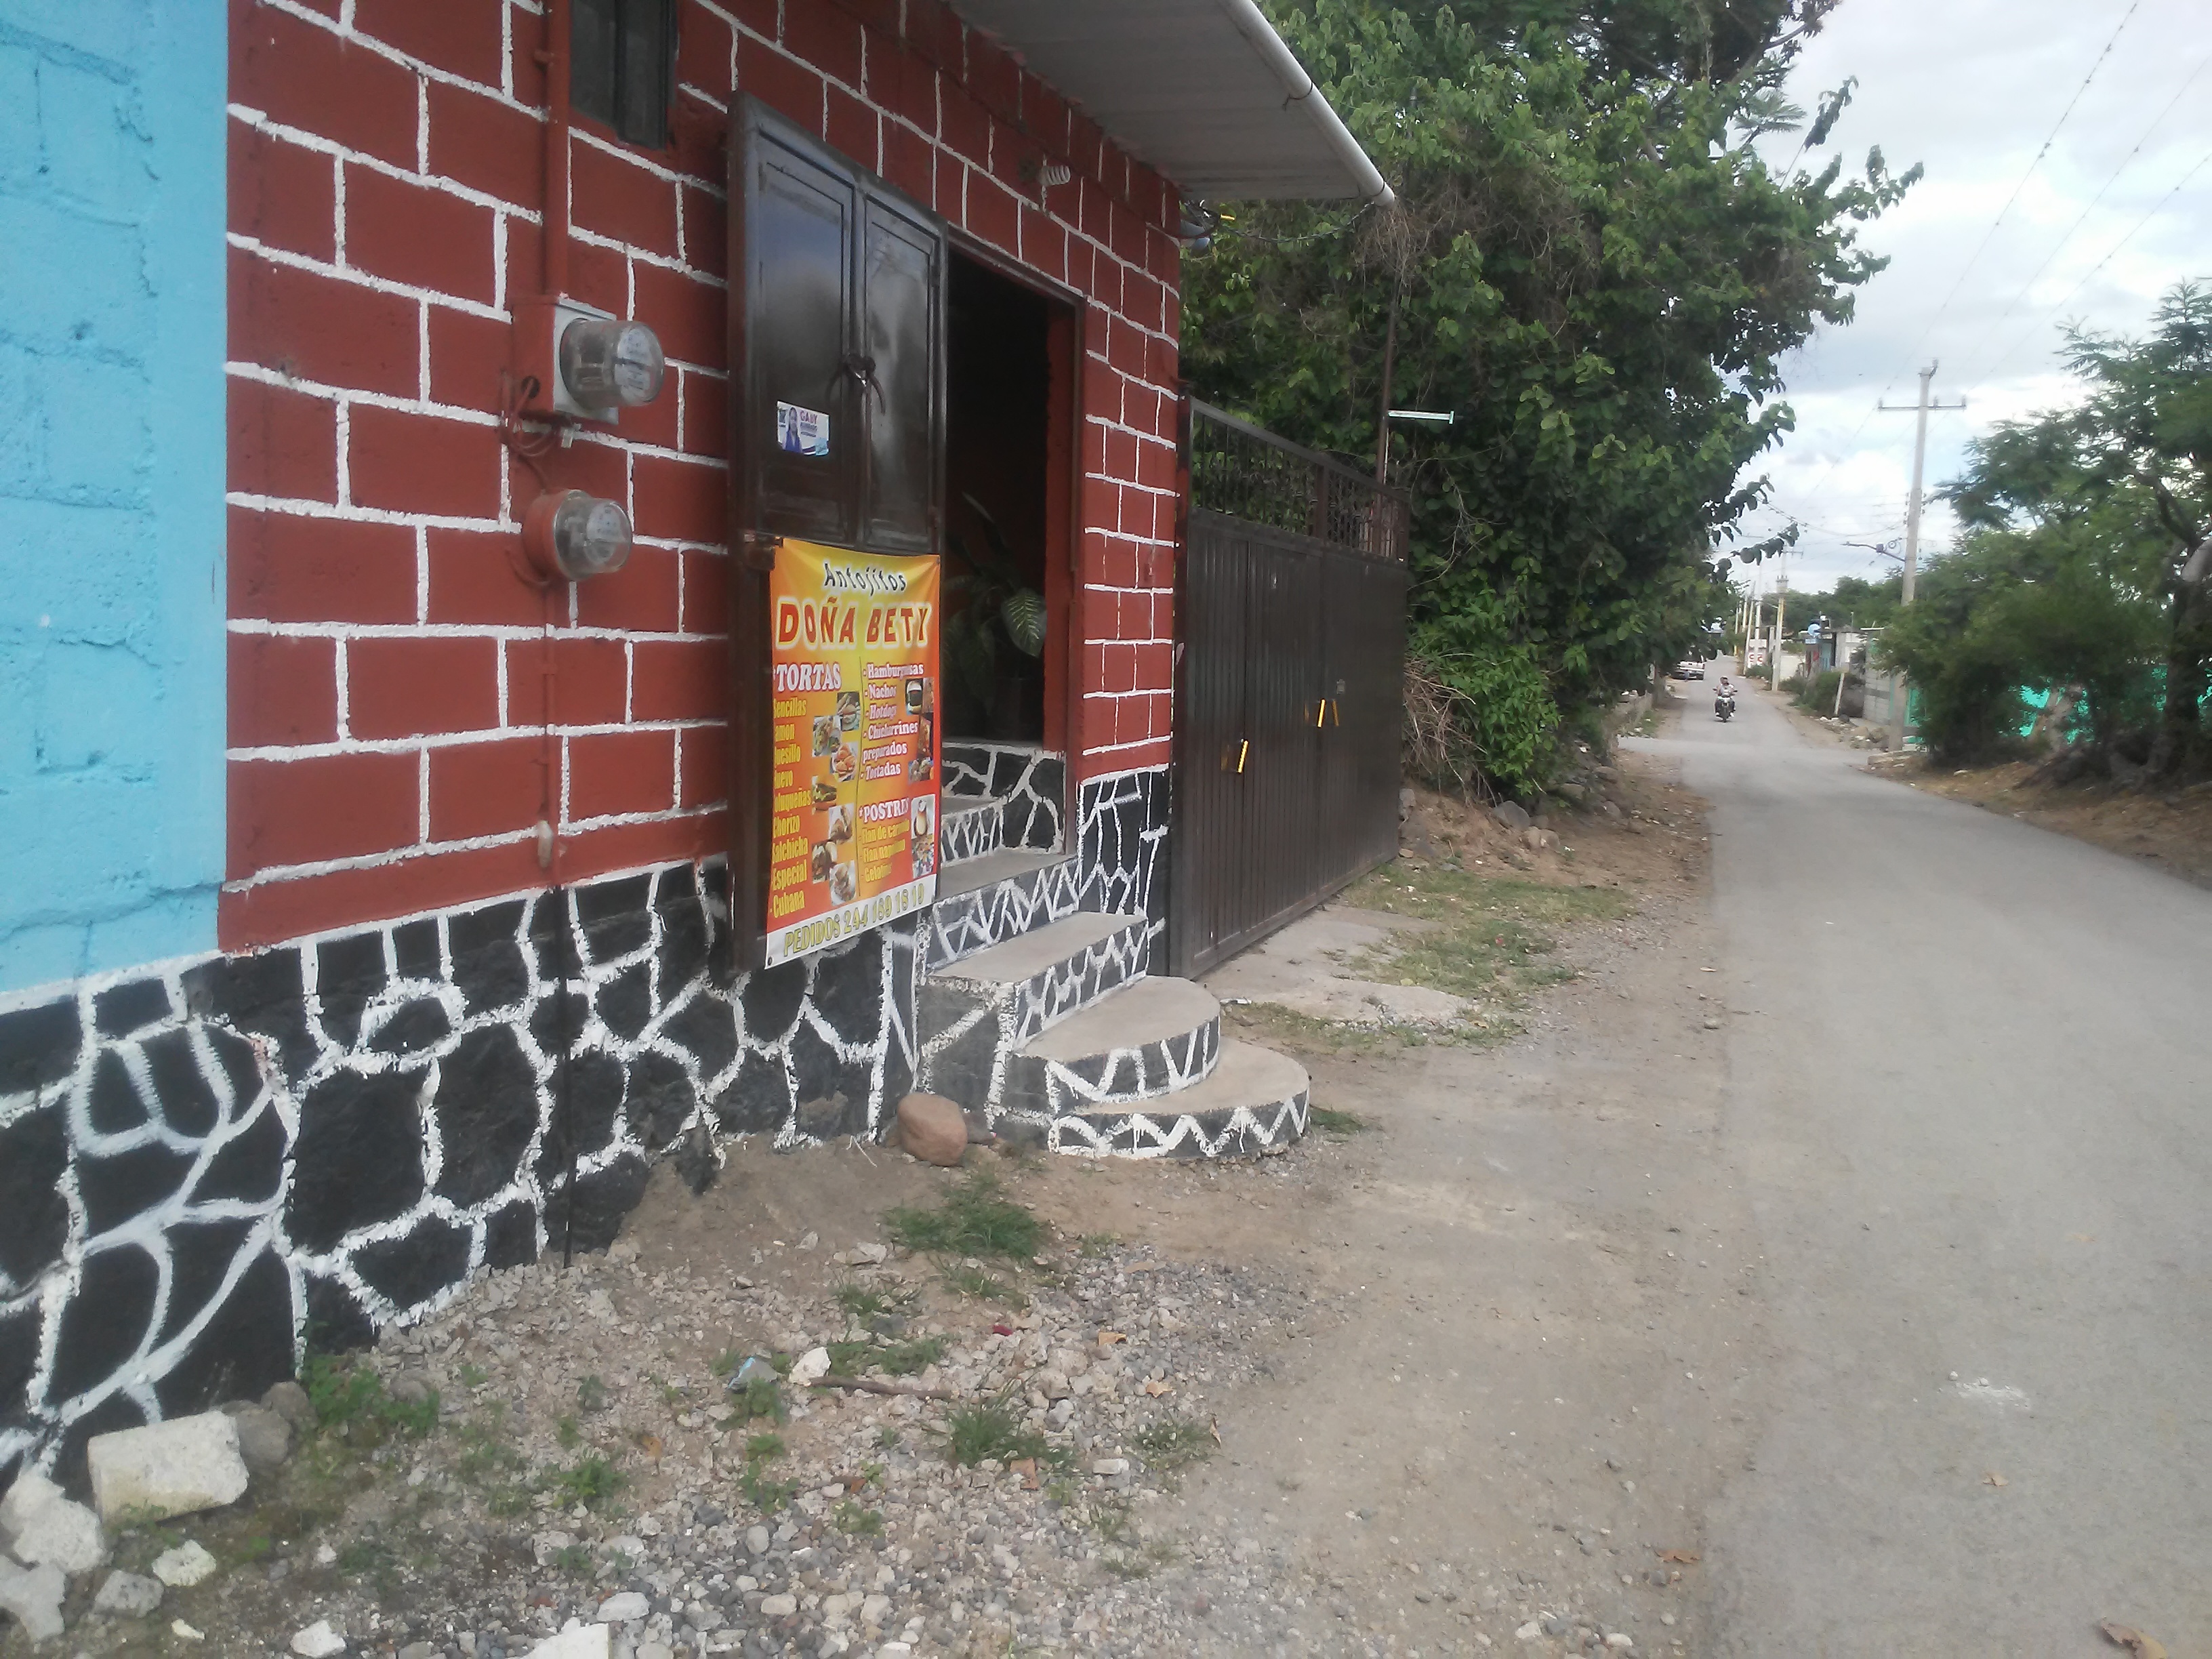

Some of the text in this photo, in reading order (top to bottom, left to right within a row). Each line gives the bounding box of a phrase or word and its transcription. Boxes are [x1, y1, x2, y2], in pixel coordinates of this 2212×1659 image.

[824, 562, 906, 596] Antojitos
[778, 596, 929, 644] DOÑA BETY
[776, 663, 842, 691] TORTAS
[775, 724, 794, 742] amon
[774, 743, 800, 765] uesillo
[774, 770, 793, 790] uevo
[775, 787, 812, 813] oluqueñas
[862, 827, 877, 844] Flan
[877, 825, 886, 840] de
[863, 846, 879, 863] Flan
[773, 859, 807, 890] Especial
[773, 890, 805, 918] Cubana
[783, 914, 841, 957] PEDIDOS
[843, 905, 868, 934] 244
